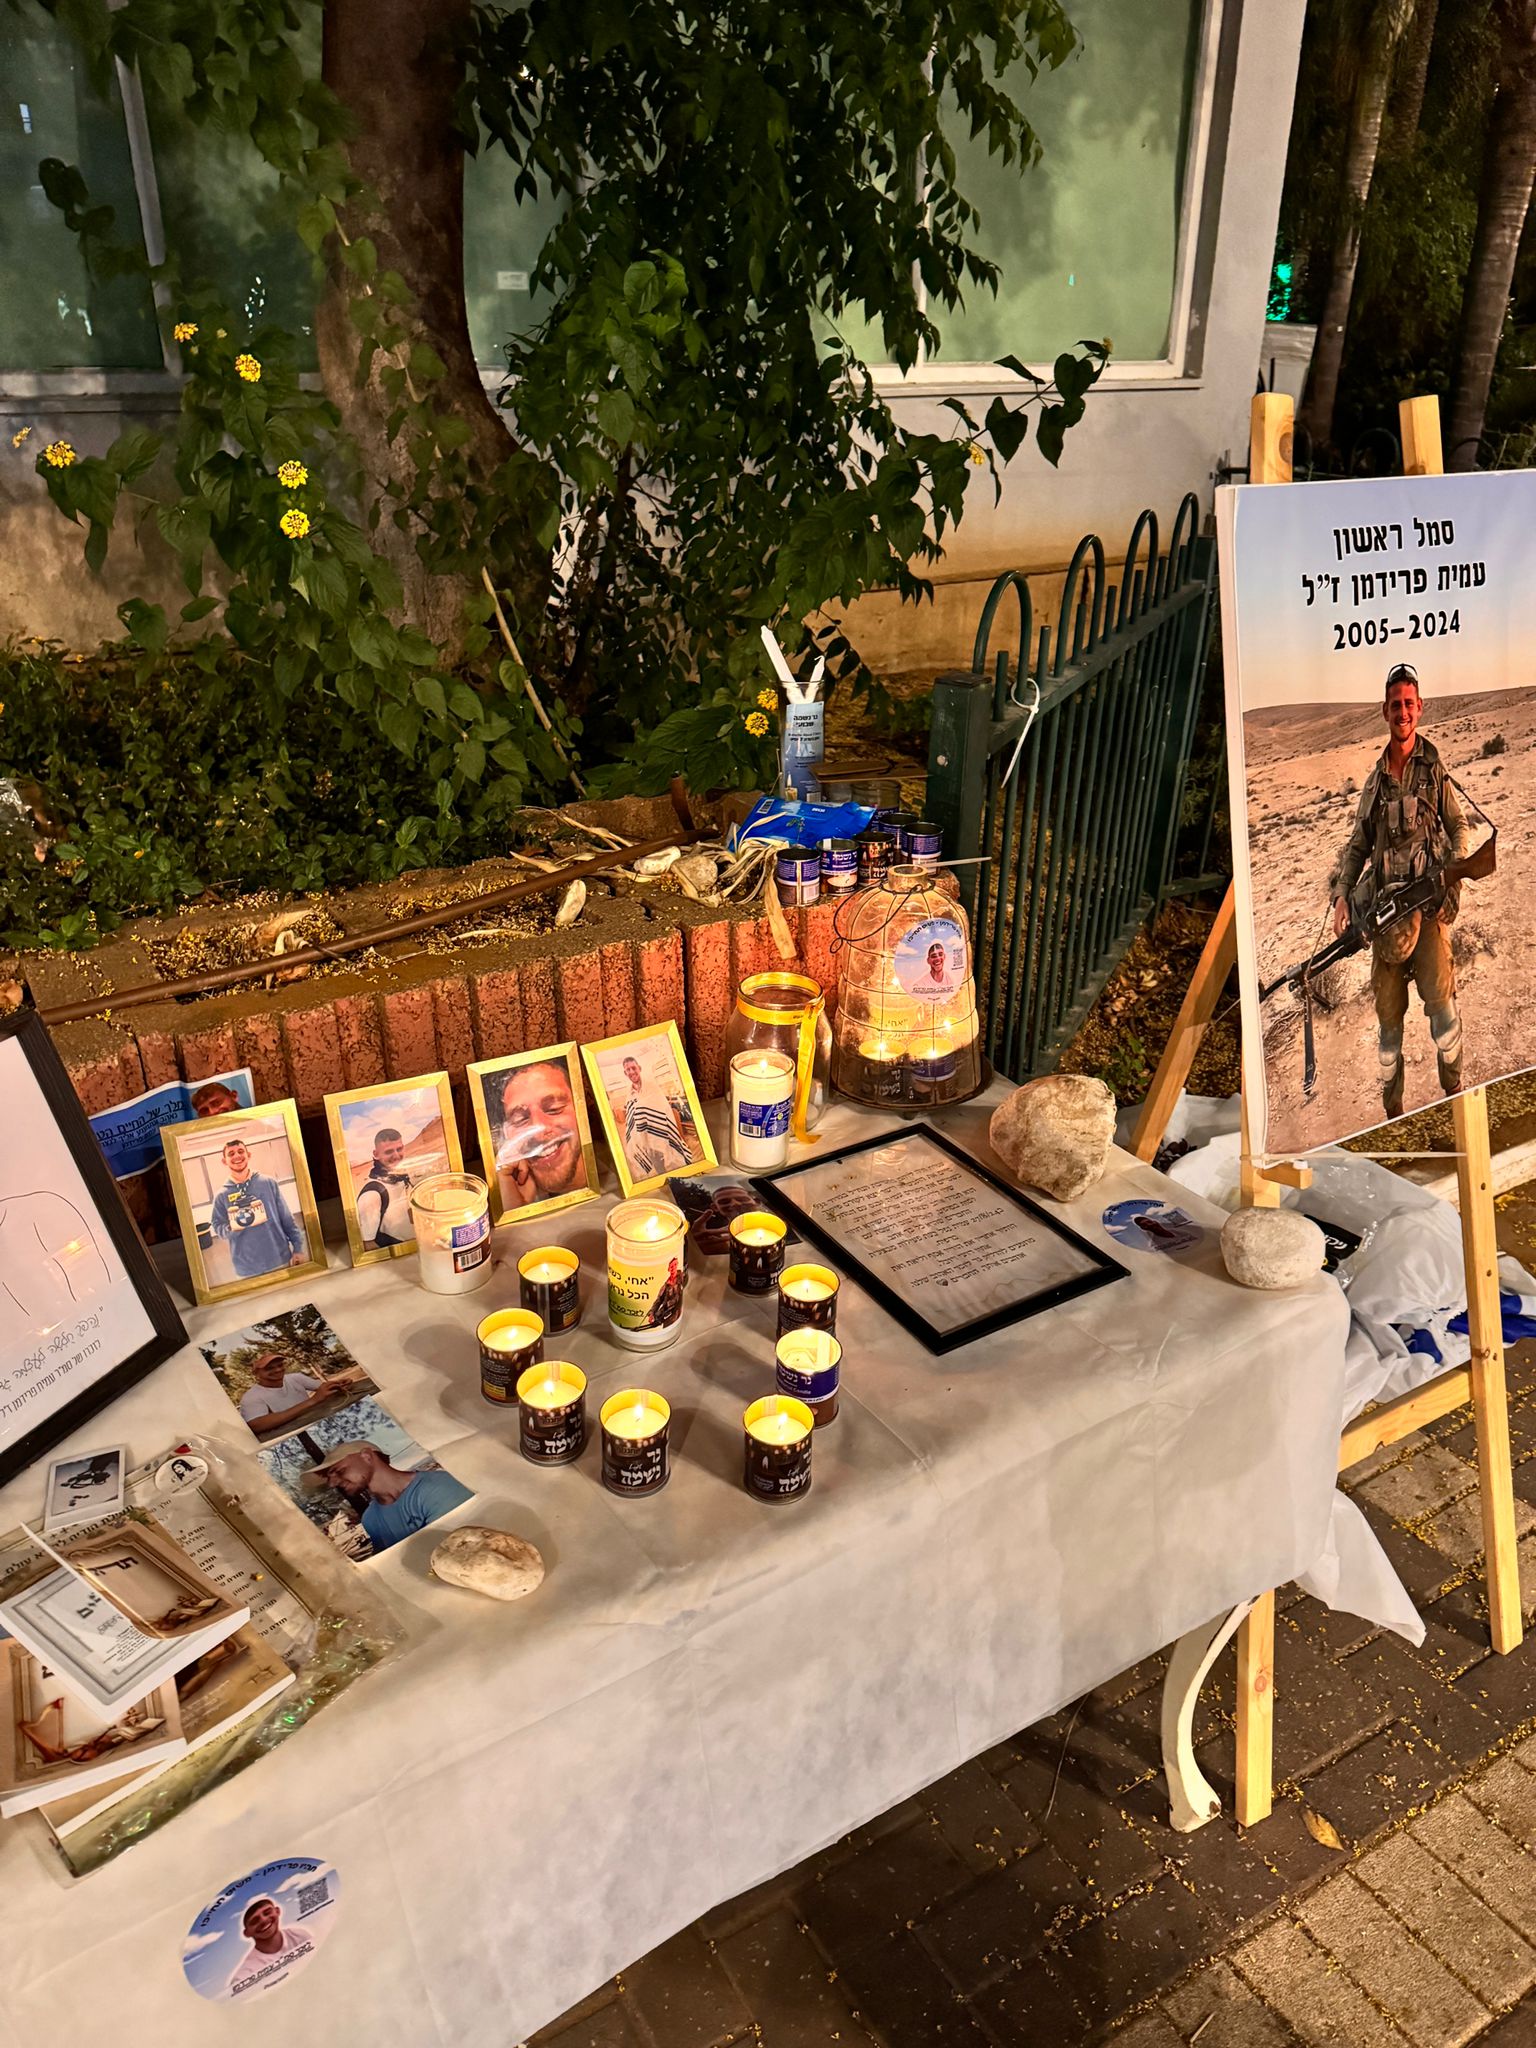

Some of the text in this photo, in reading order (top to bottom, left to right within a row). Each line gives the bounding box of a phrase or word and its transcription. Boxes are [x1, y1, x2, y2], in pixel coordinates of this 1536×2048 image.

[1333, 517, 1455, 560] סמל ראשון
[1438, 561, 1486, 592] עמית
[1352, 567, 1428, 605] פרידמן
[145, 1106, 161, 1118] של
[116, 1115, 145, 1132] החיים
[628, 1289, 650, 1300] הכל
[72, 1353, 83, 1364] של
[36, 1373, 55, 1389] עמית
[800, 1376, 812, 1385] נר
[12, 1387, 37, 1407] פרידמן
[647, 1448, 661, 1464] נר
[620, 1465, 662, 1486] נשמה
[263, 1862, 299, 1877] פרידמן
